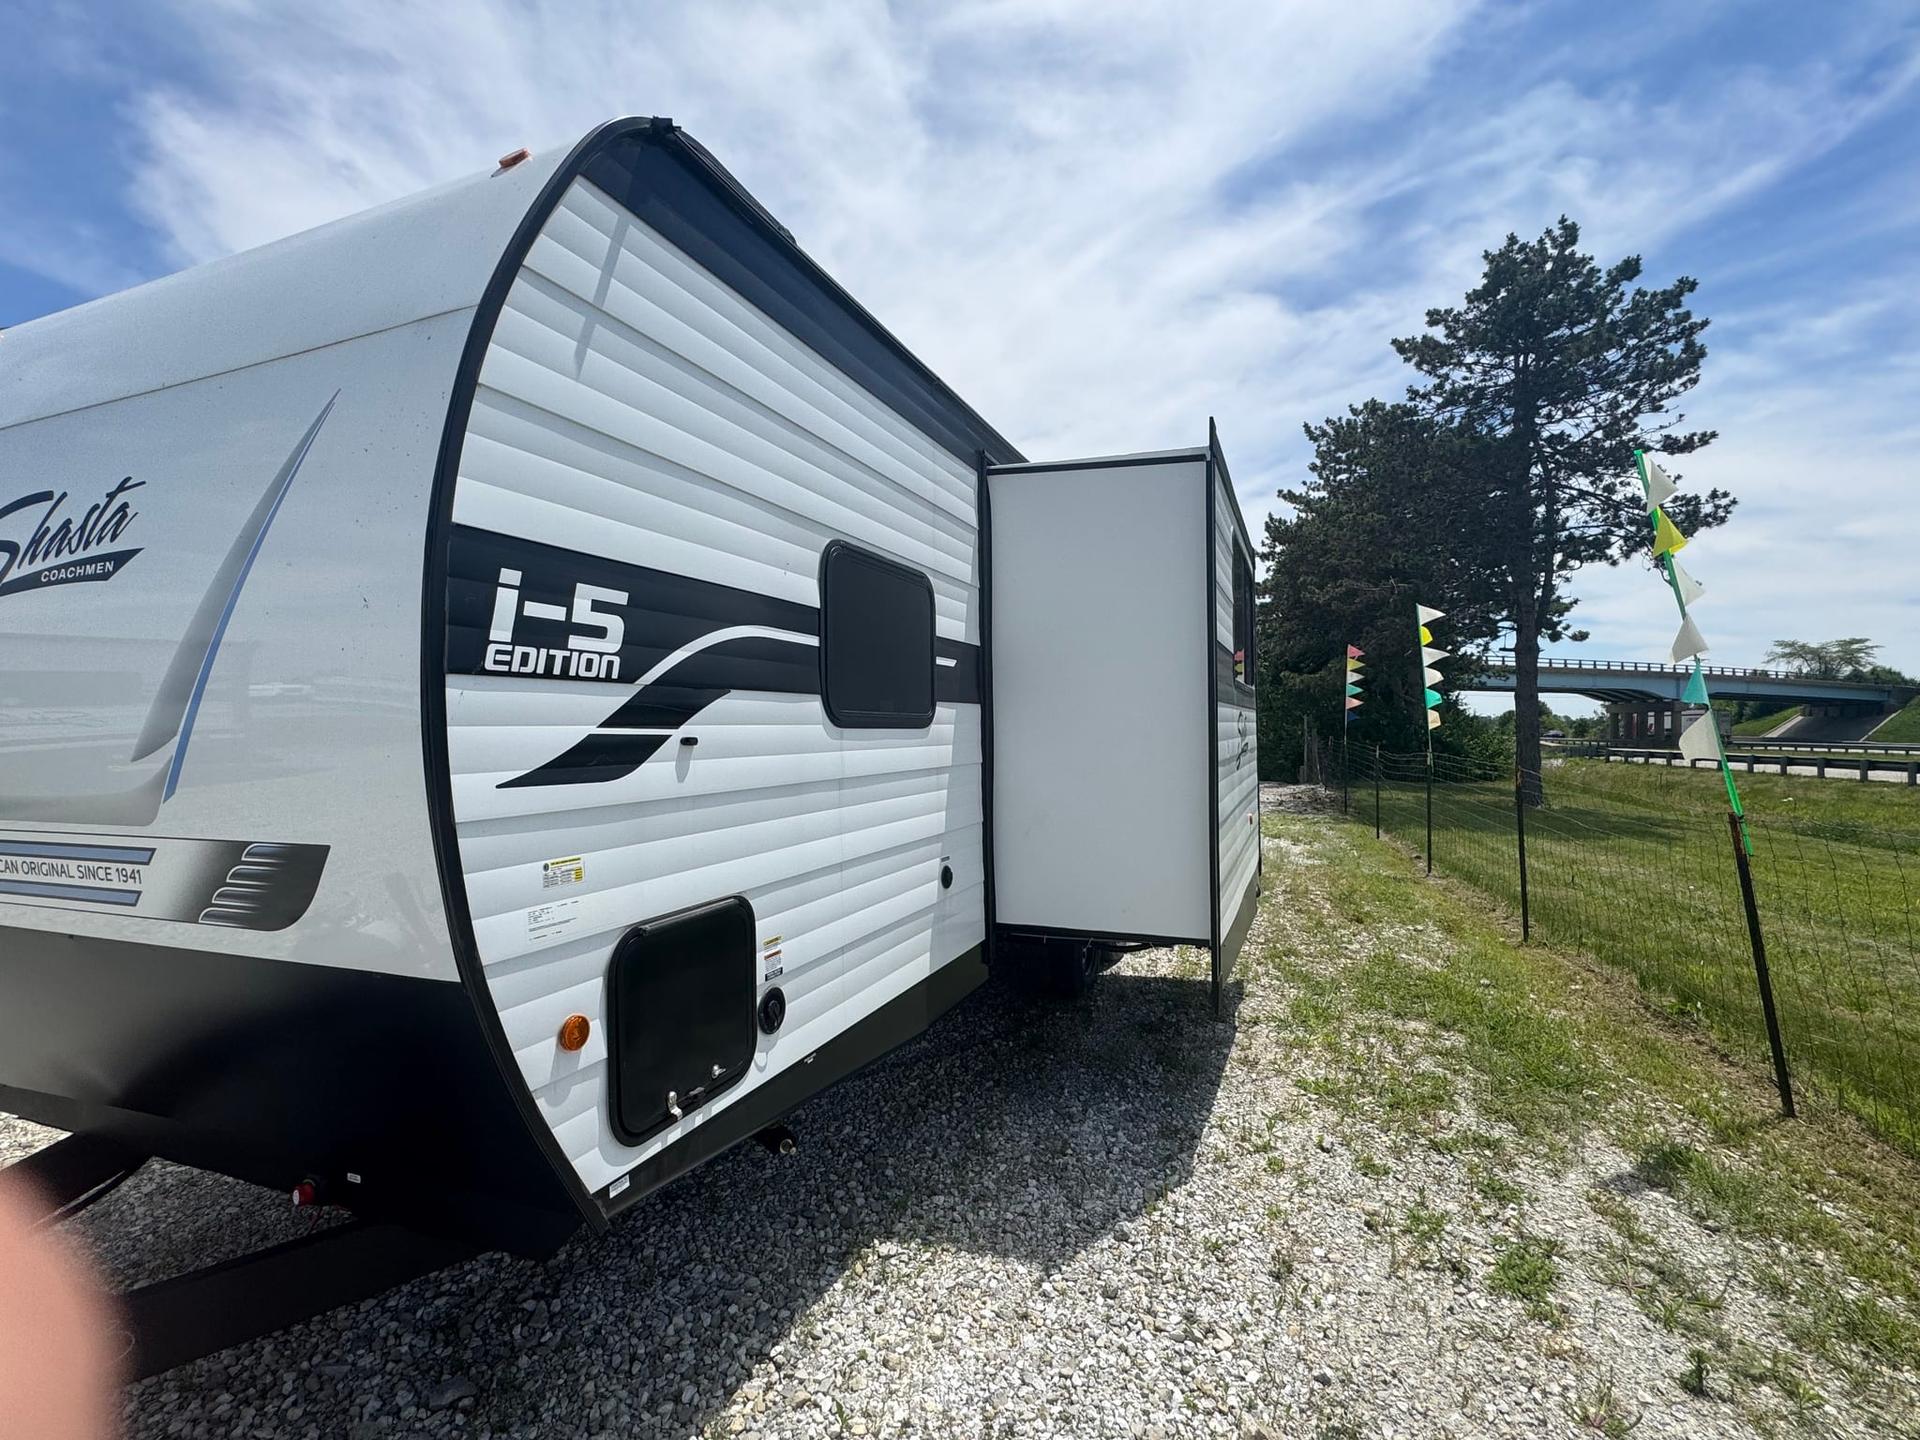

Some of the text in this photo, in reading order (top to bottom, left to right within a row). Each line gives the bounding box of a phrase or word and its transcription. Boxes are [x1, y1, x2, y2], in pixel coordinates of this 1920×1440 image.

[40, 561, 114, 582] COACHMEN
[484, 643, 621, 680] EDITION
[21, 860, 75, 879] ORIGINAL
[77, 864, 113, 881] SINCE
[115, 867, 142, 884] 1941
